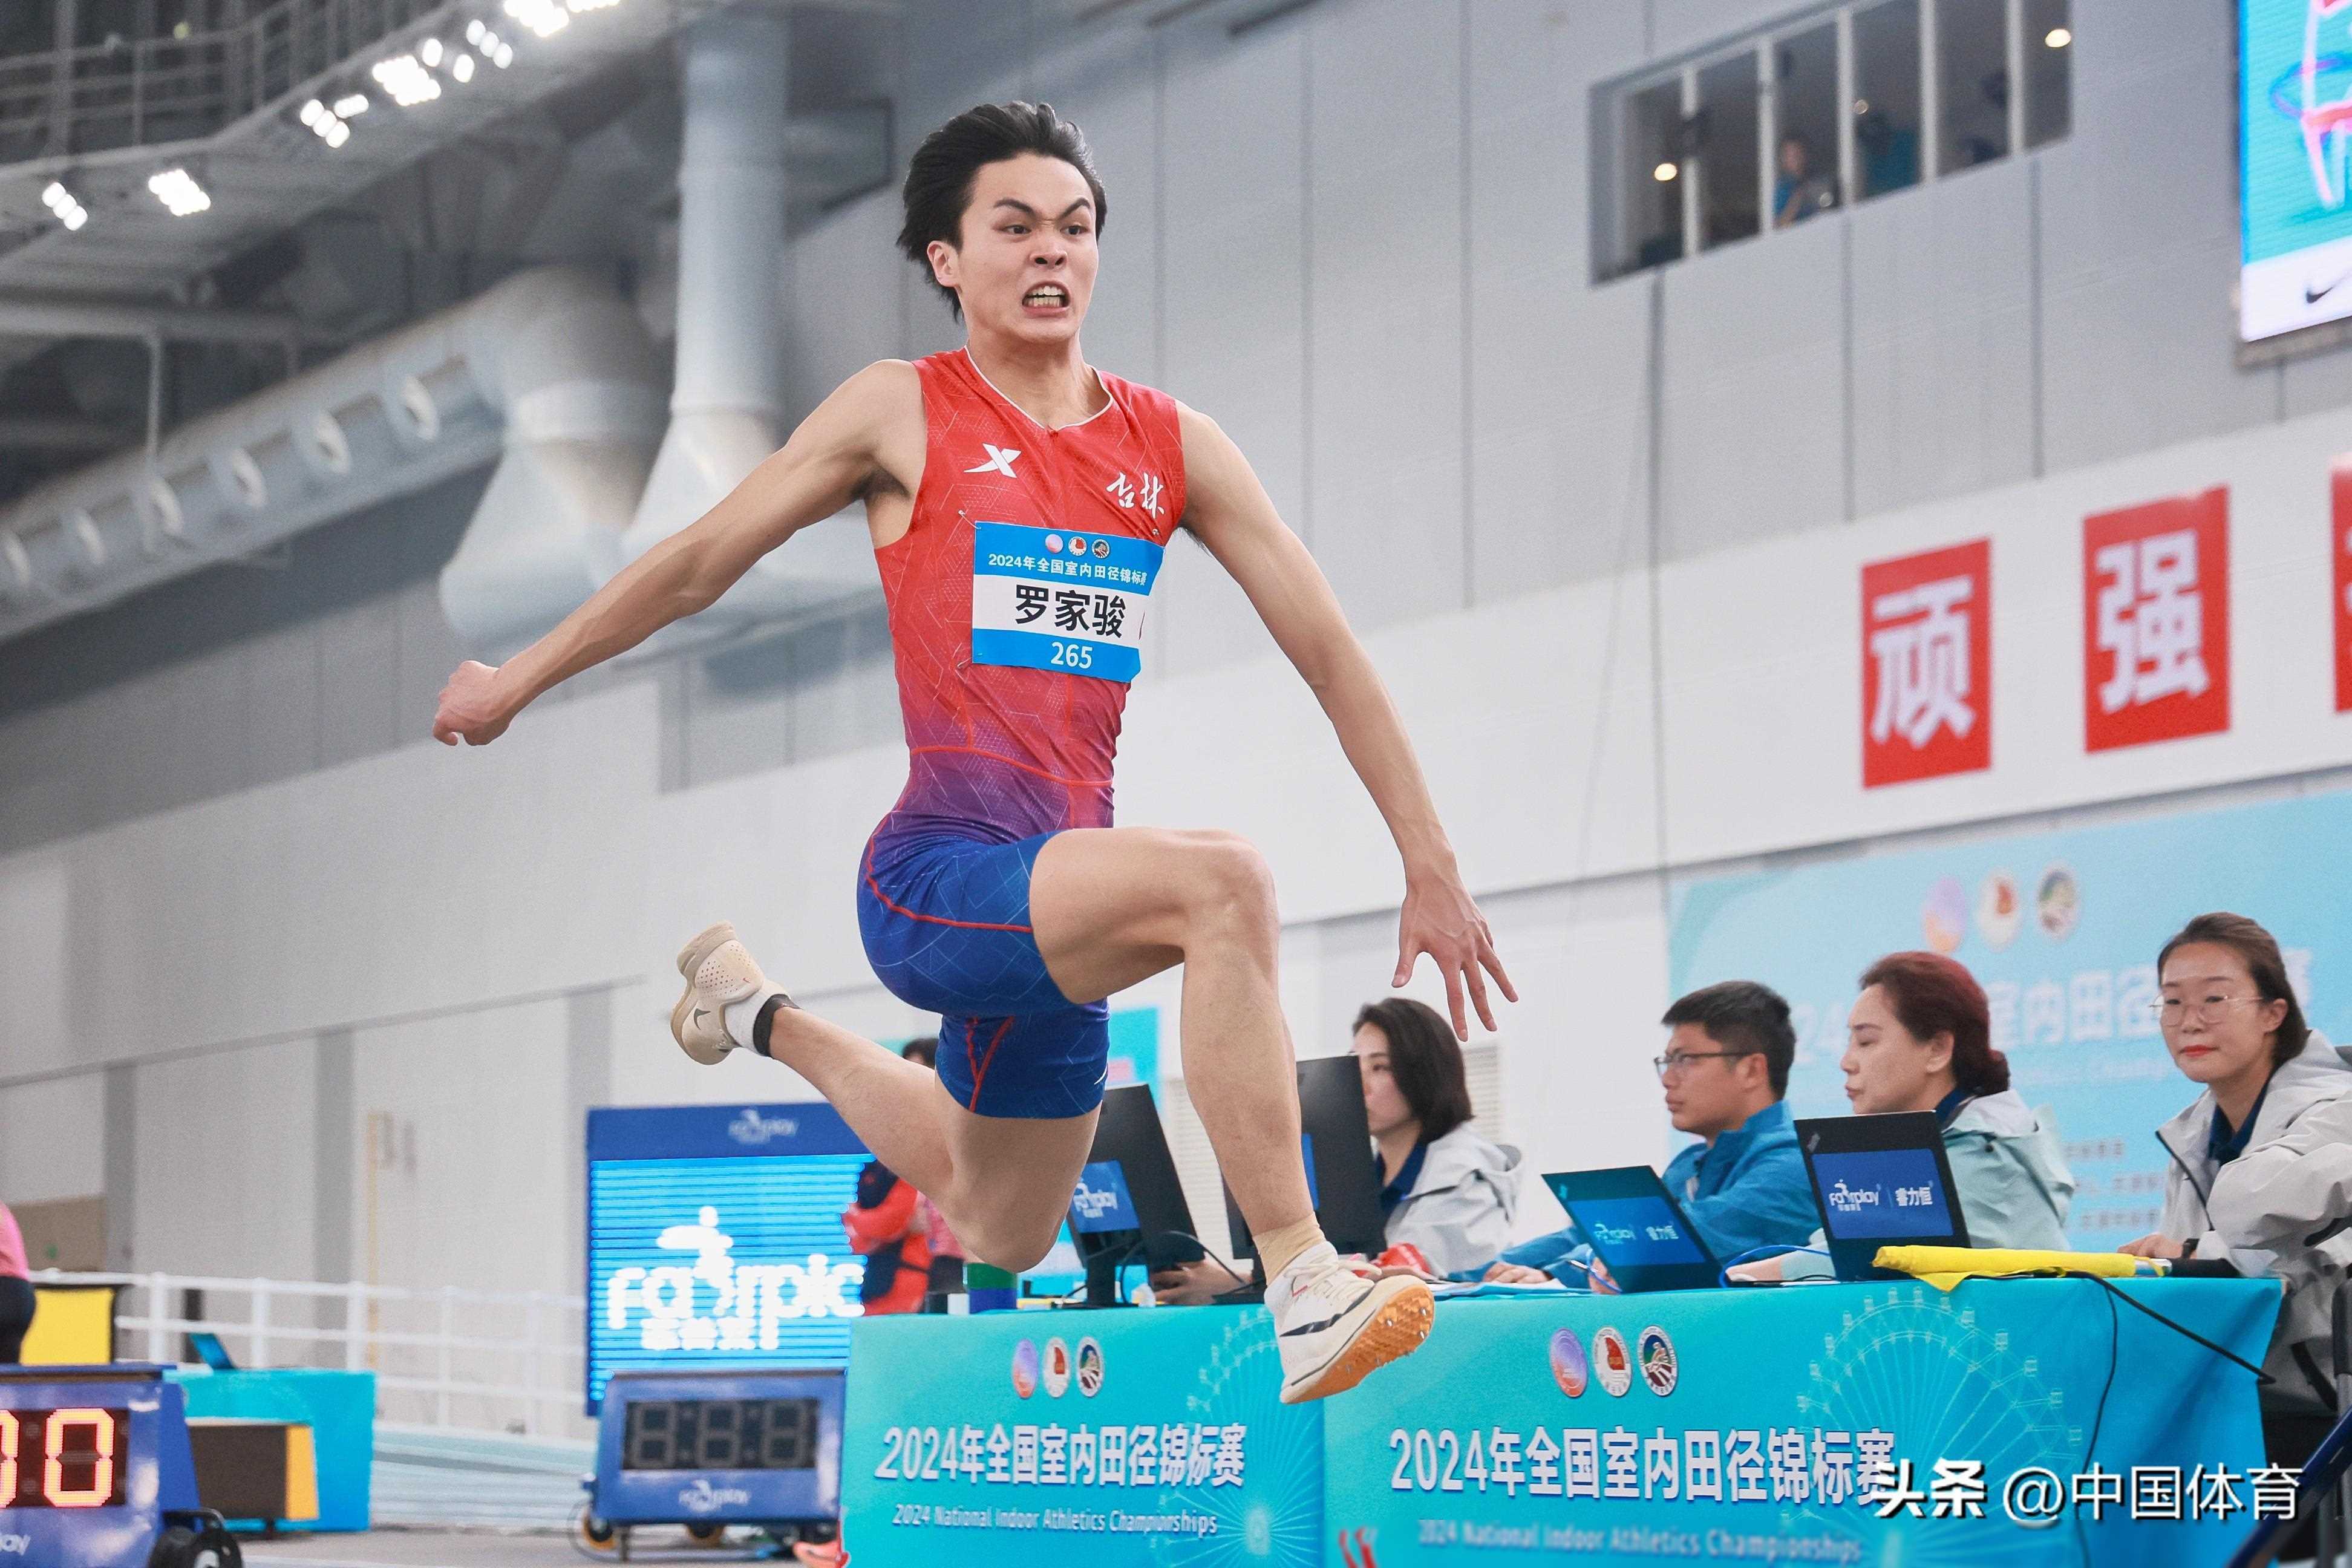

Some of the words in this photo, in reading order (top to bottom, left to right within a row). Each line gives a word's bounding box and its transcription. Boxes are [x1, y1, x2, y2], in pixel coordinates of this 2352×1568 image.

[1014, 584, 1126, 639] 罗家骏
[1870, 573, 1975, 749] 顽
[2095, 528, 2210, 715] 强
[1050, 641, 1093, 669] 265
[0, 1408, 115, 1508] 0
[875, 1423, 1246, 1487] 2024年全国室内田径锦标赛
[892, 1504, 930, 1526] 2024
[935, 1506, 992, 1527] National
[996, 1507, 1039, 1529] Indoor
[1043, 1508, 1105, 1532] Athletics
[1109, 1510, 1218, 1538] Championships
[1463, 1520, 1538, 1549] National
[1543, 1523, 1604, 1550] Indoor
[1611, 1526, 1700, 1555] Athletics
[1707, 1529, 1863, 1563] Championships
